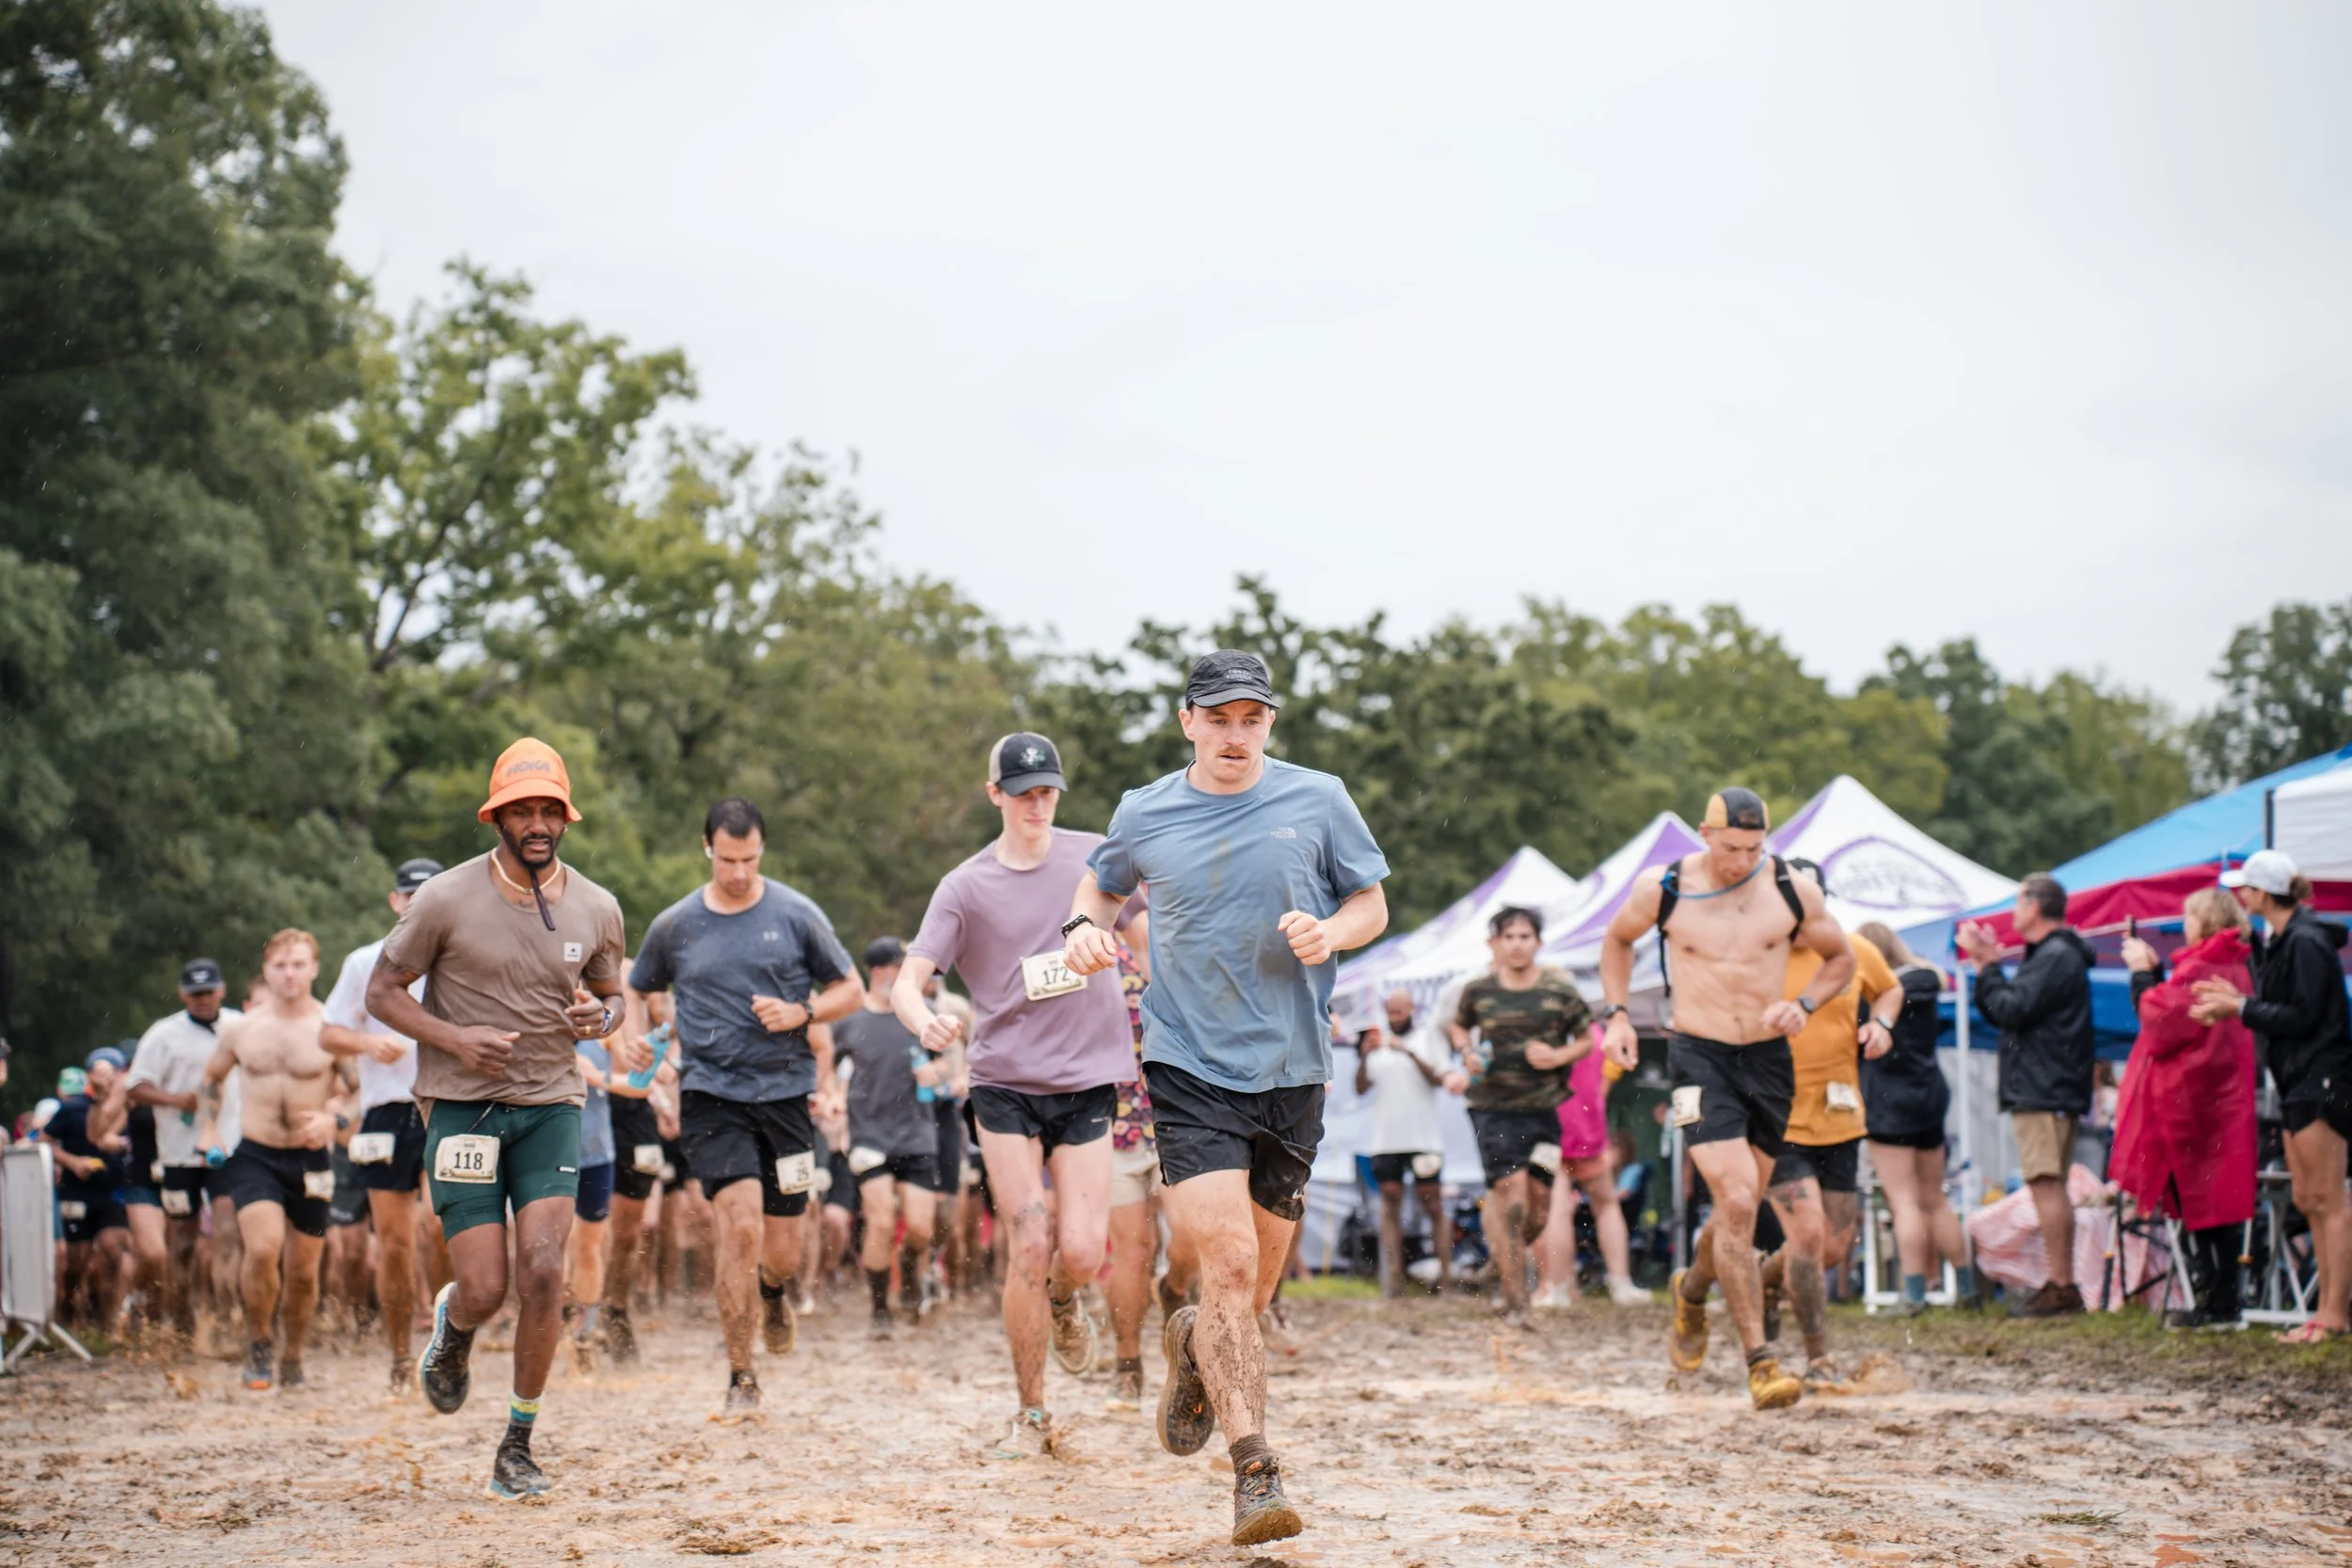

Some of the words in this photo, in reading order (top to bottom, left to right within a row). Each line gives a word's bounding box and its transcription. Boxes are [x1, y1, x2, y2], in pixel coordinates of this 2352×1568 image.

[506, 759, 550, 777] HOKA
[1042, 966, 1070, 985] 172
[453, 1151, 484, 1171] 118
